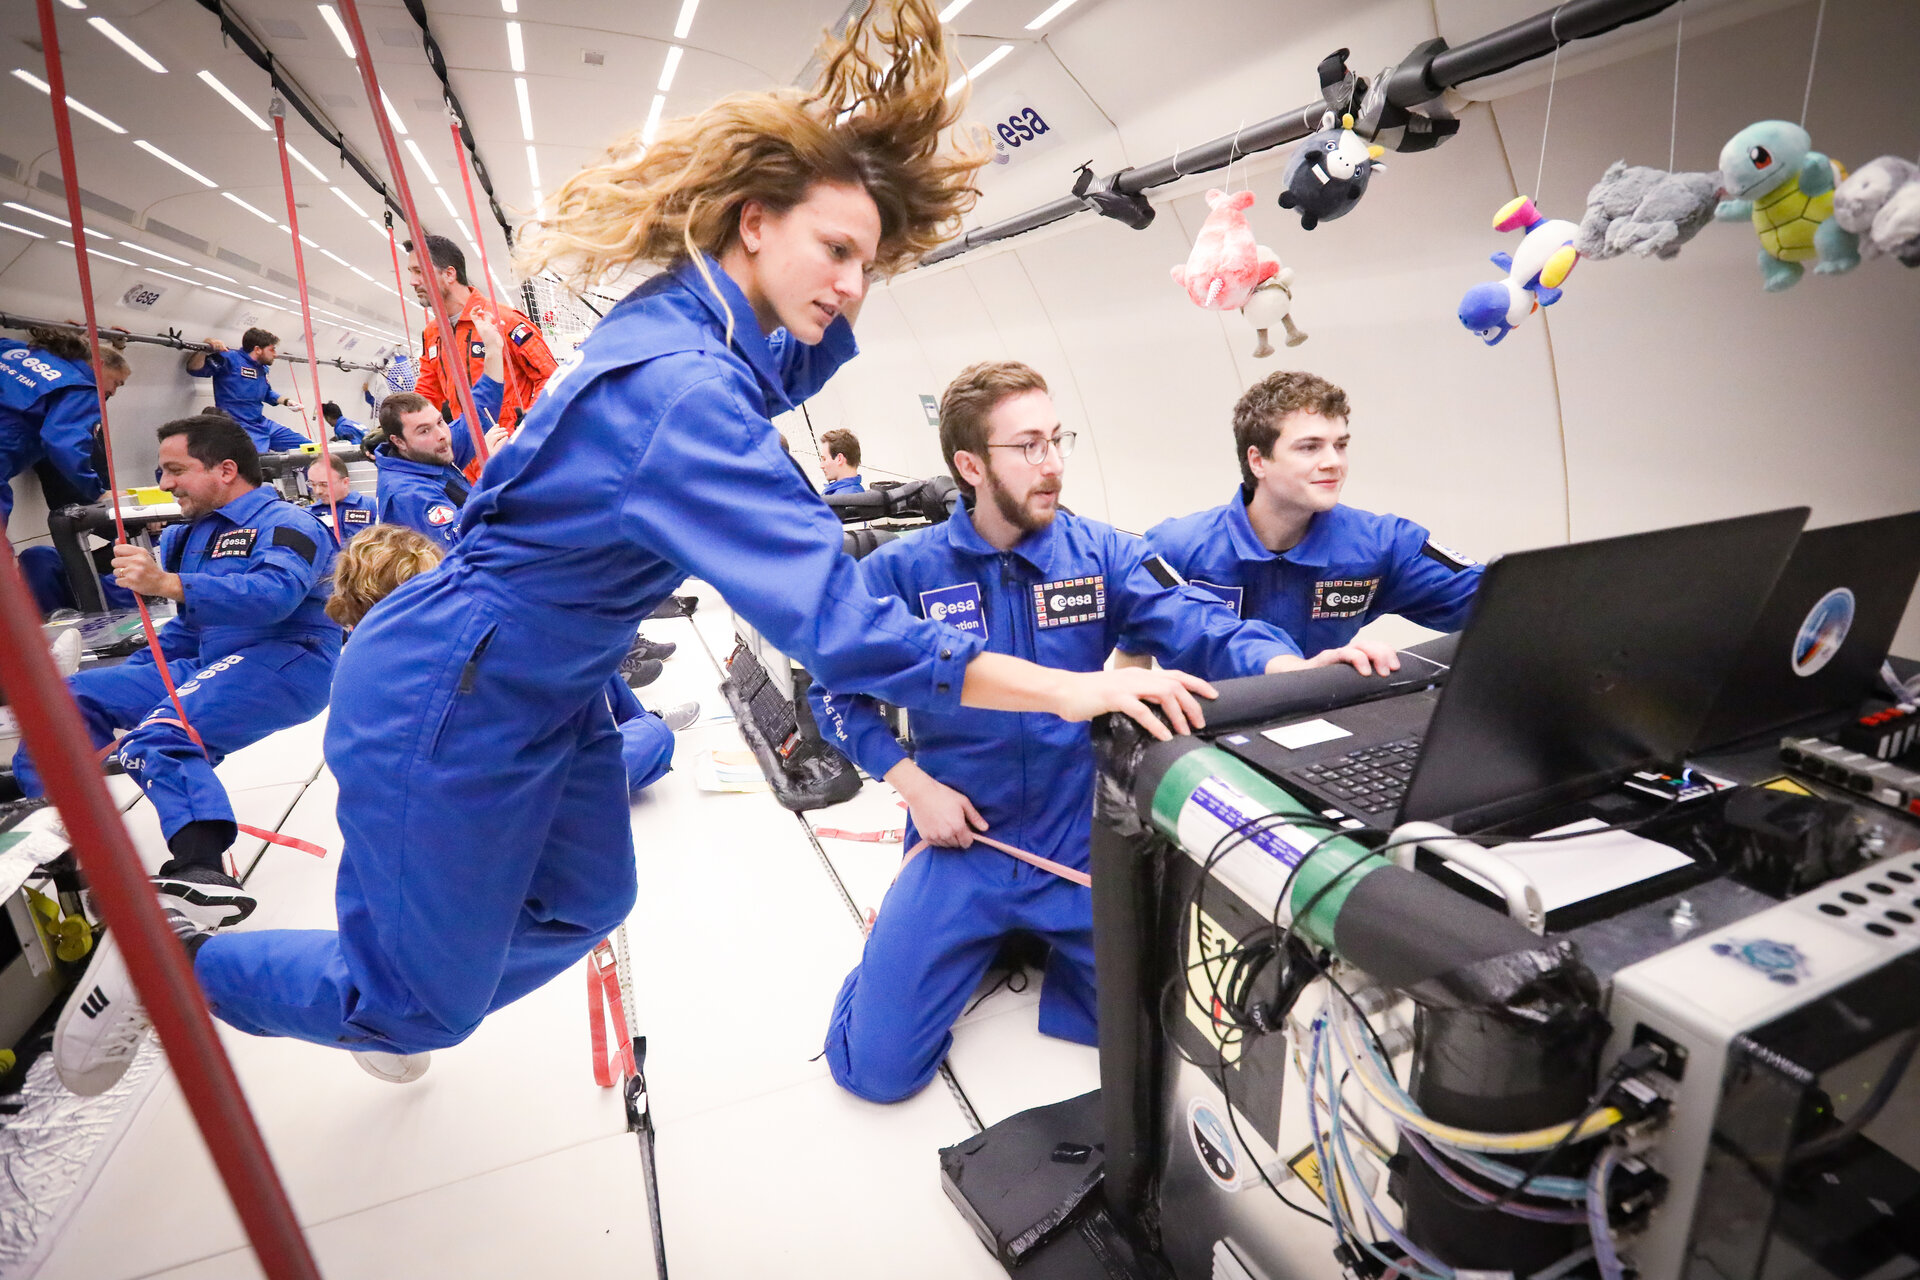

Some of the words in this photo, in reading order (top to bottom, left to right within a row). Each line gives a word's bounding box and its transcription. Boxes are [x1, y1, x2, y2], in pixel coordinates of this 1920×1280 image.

[996, 107, 1050, 148] esa
[135, 290, 161, 306] esa
[22, 357, 62, 382] esa
[947, 599, 976, 615] esa
[1067, 593, 1092, 607] esa
[1341, 593, 1366, 604] esa
[195, 654, 245, 680] esa
[831, 712, 849, 742] TEAM
